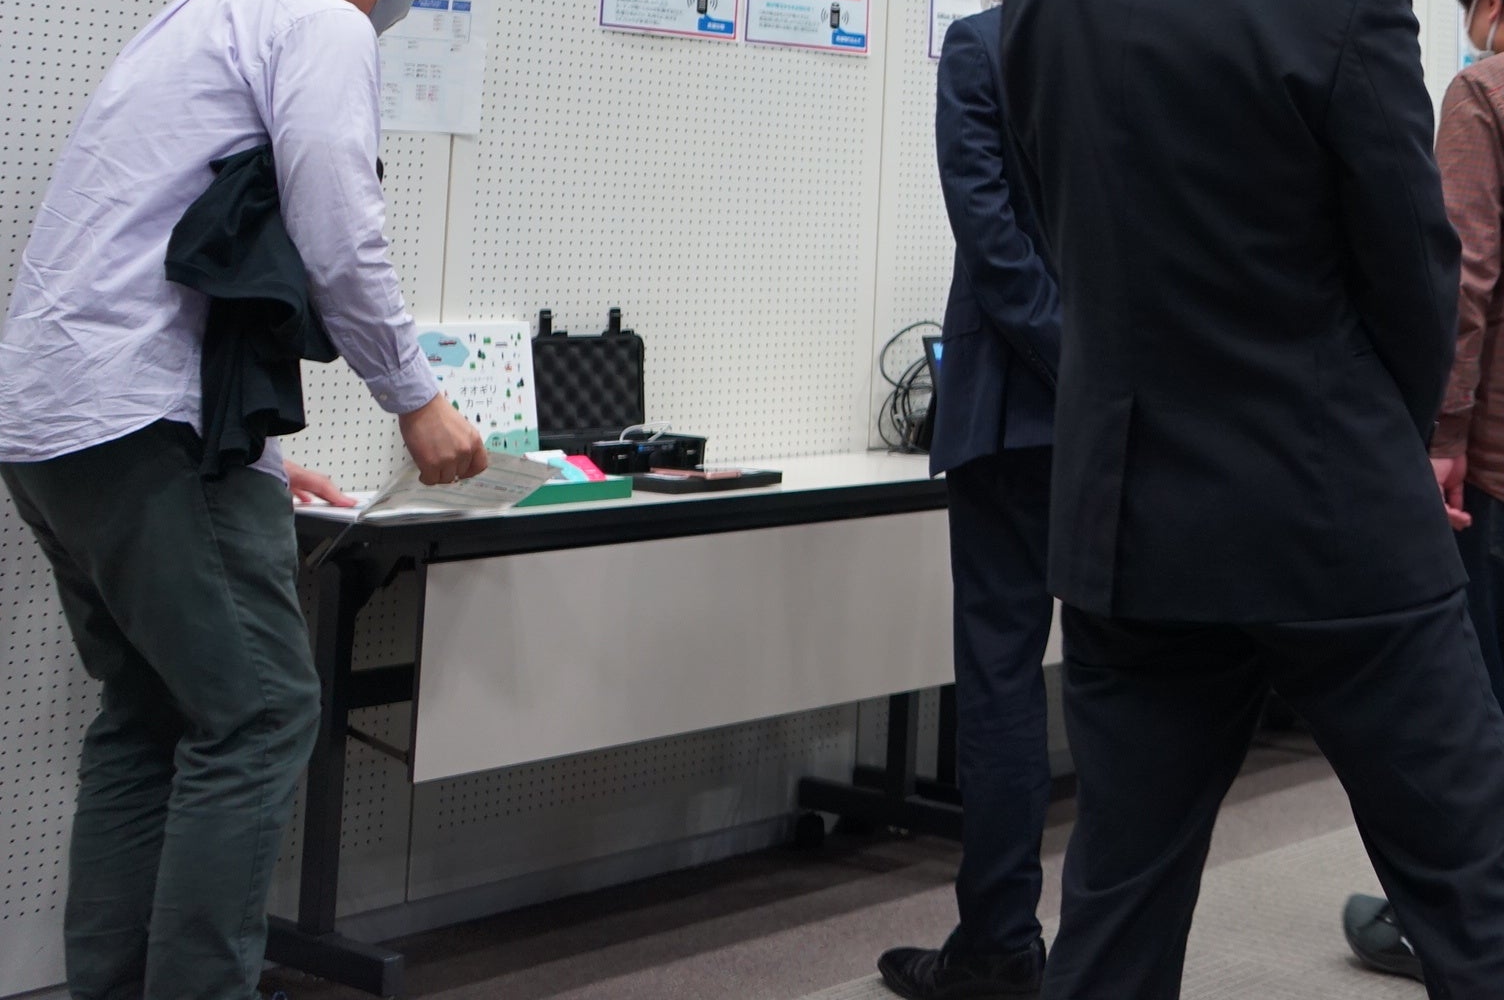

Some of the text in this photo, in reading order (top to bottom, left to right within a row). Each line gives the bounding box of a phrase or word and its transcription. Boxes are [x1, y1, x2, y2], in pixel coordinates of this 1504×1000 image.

[460, 384, 497, 396] オオギリ
[465, 397, 493, 408] カード
